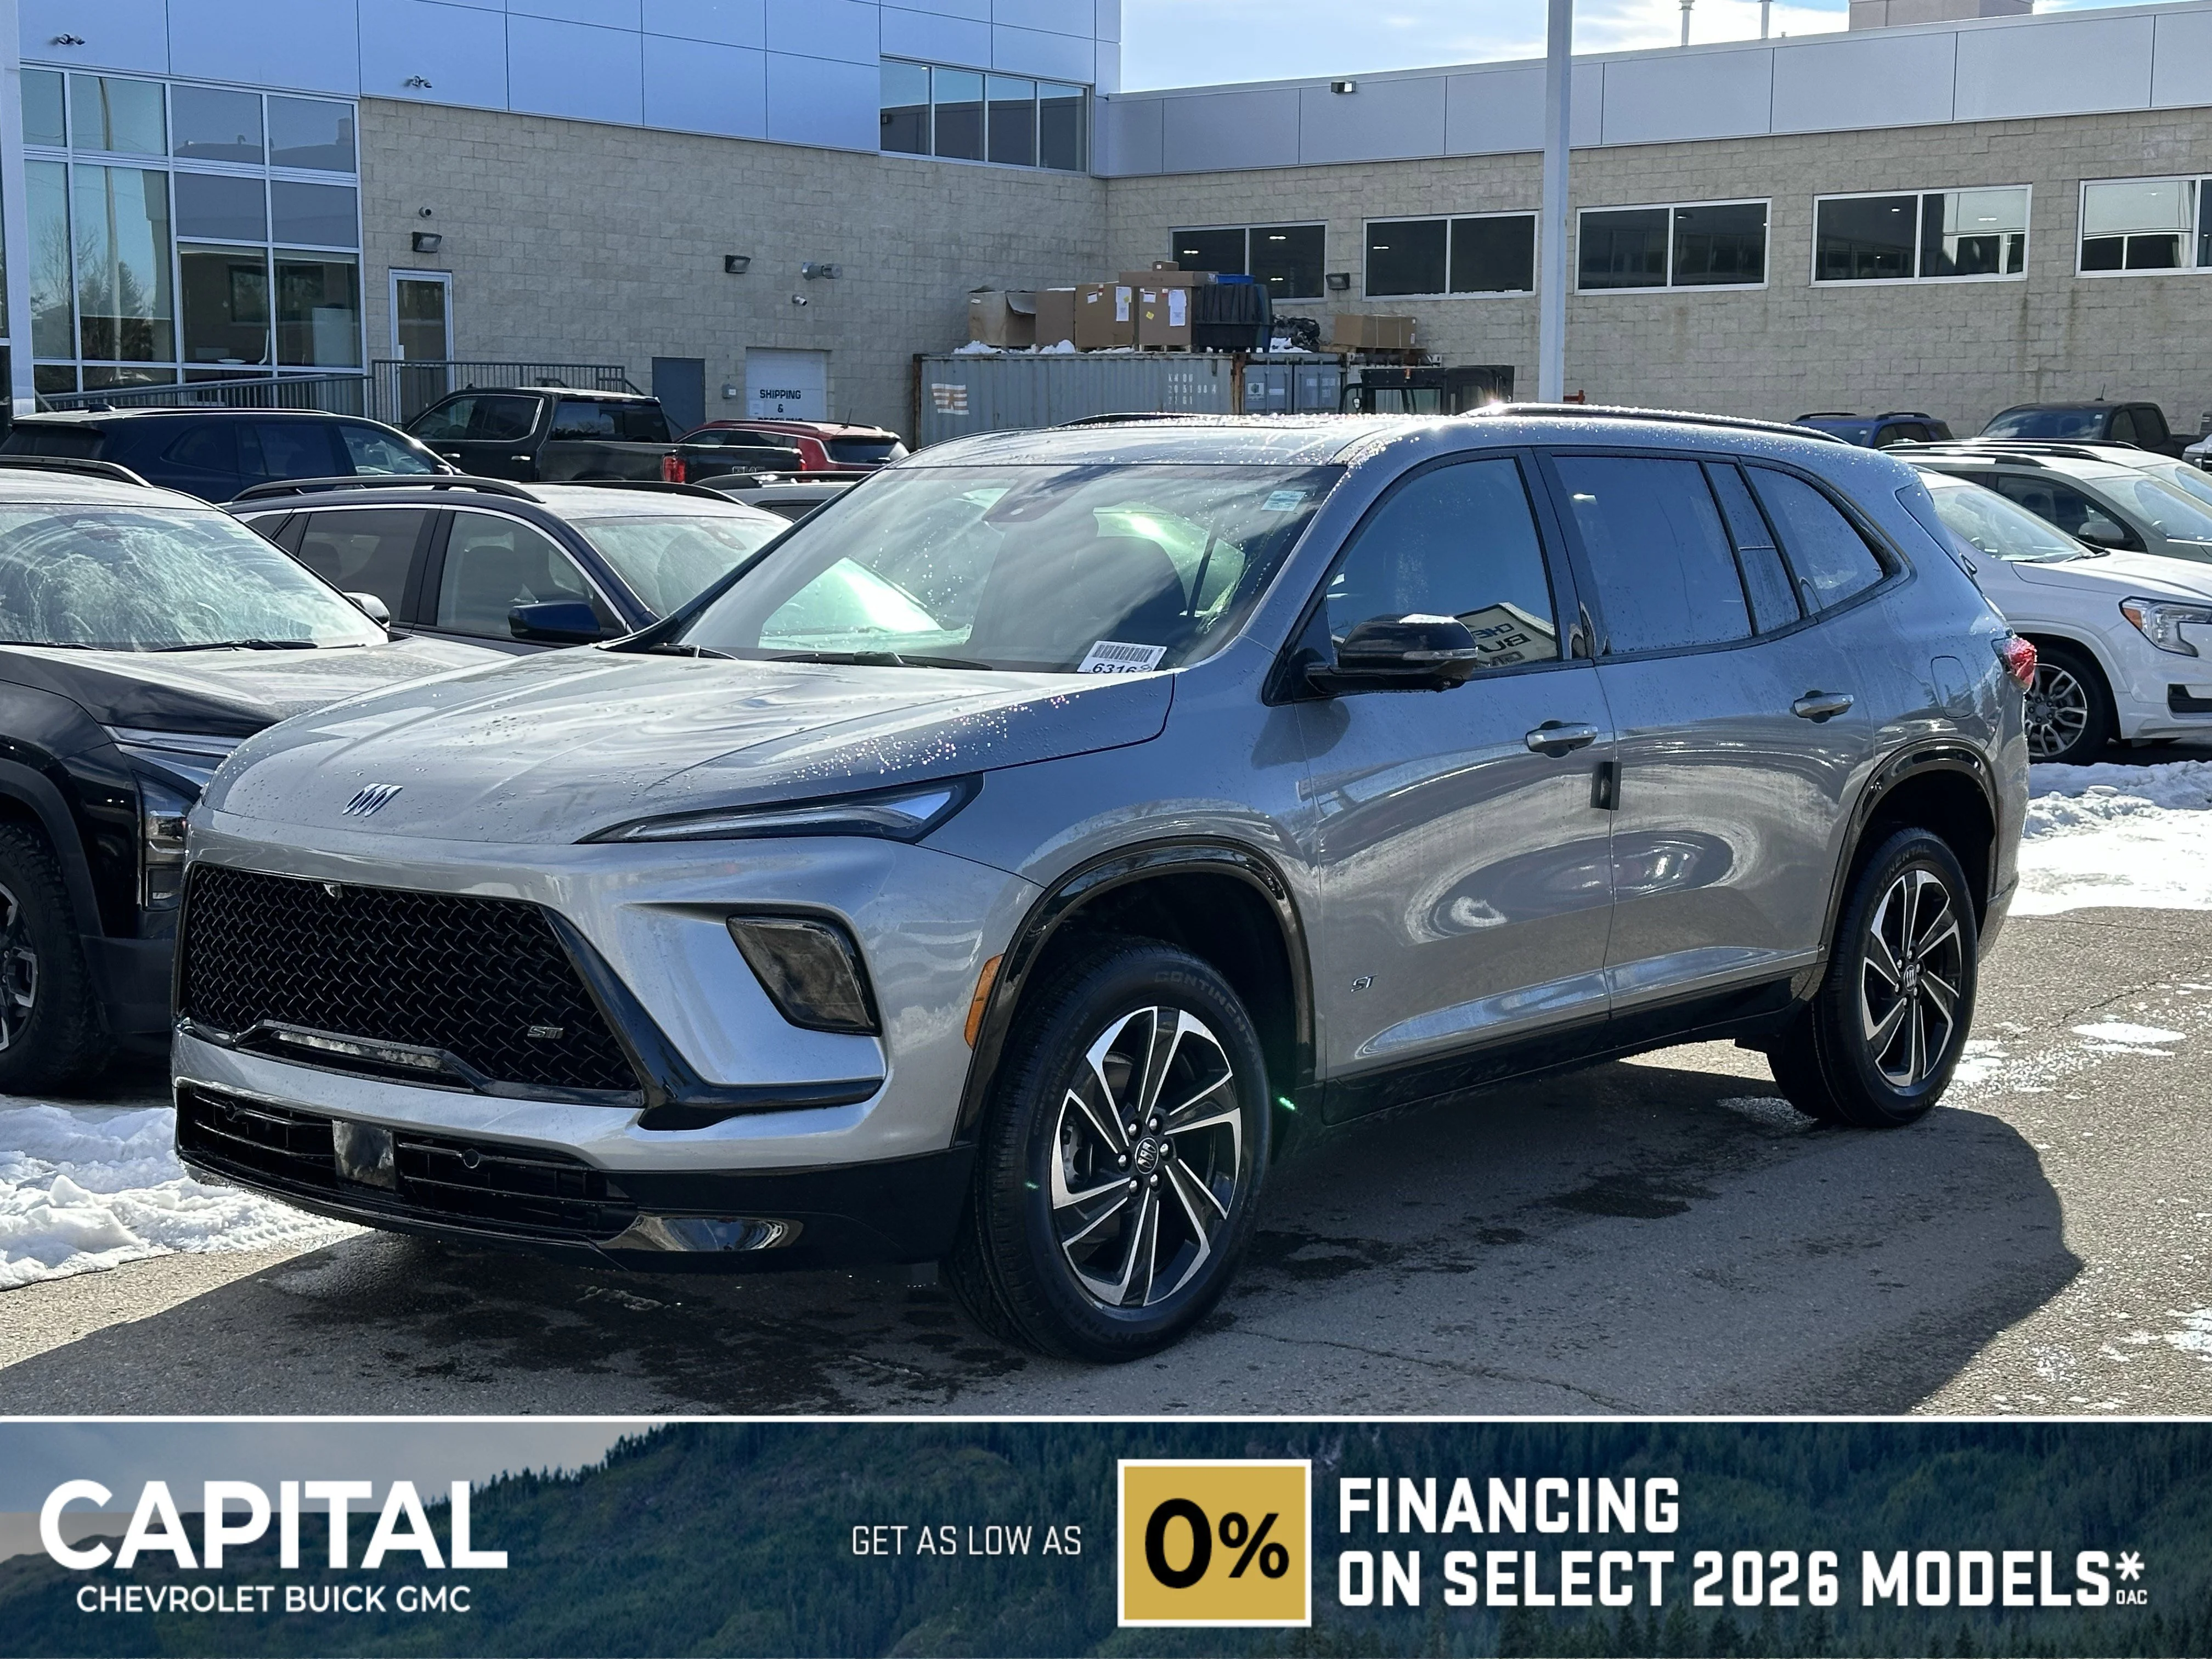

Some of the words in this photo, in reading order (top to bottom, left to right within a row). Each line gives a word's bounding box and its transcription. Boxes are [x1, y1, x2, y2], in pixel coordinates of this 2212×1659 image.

[759, 389, 802, 399] SHIPPING
[777, 404, 784, 413] &
[1350, 973, 1378, 992] ST
[527, 1025, 563, 1039] ST
